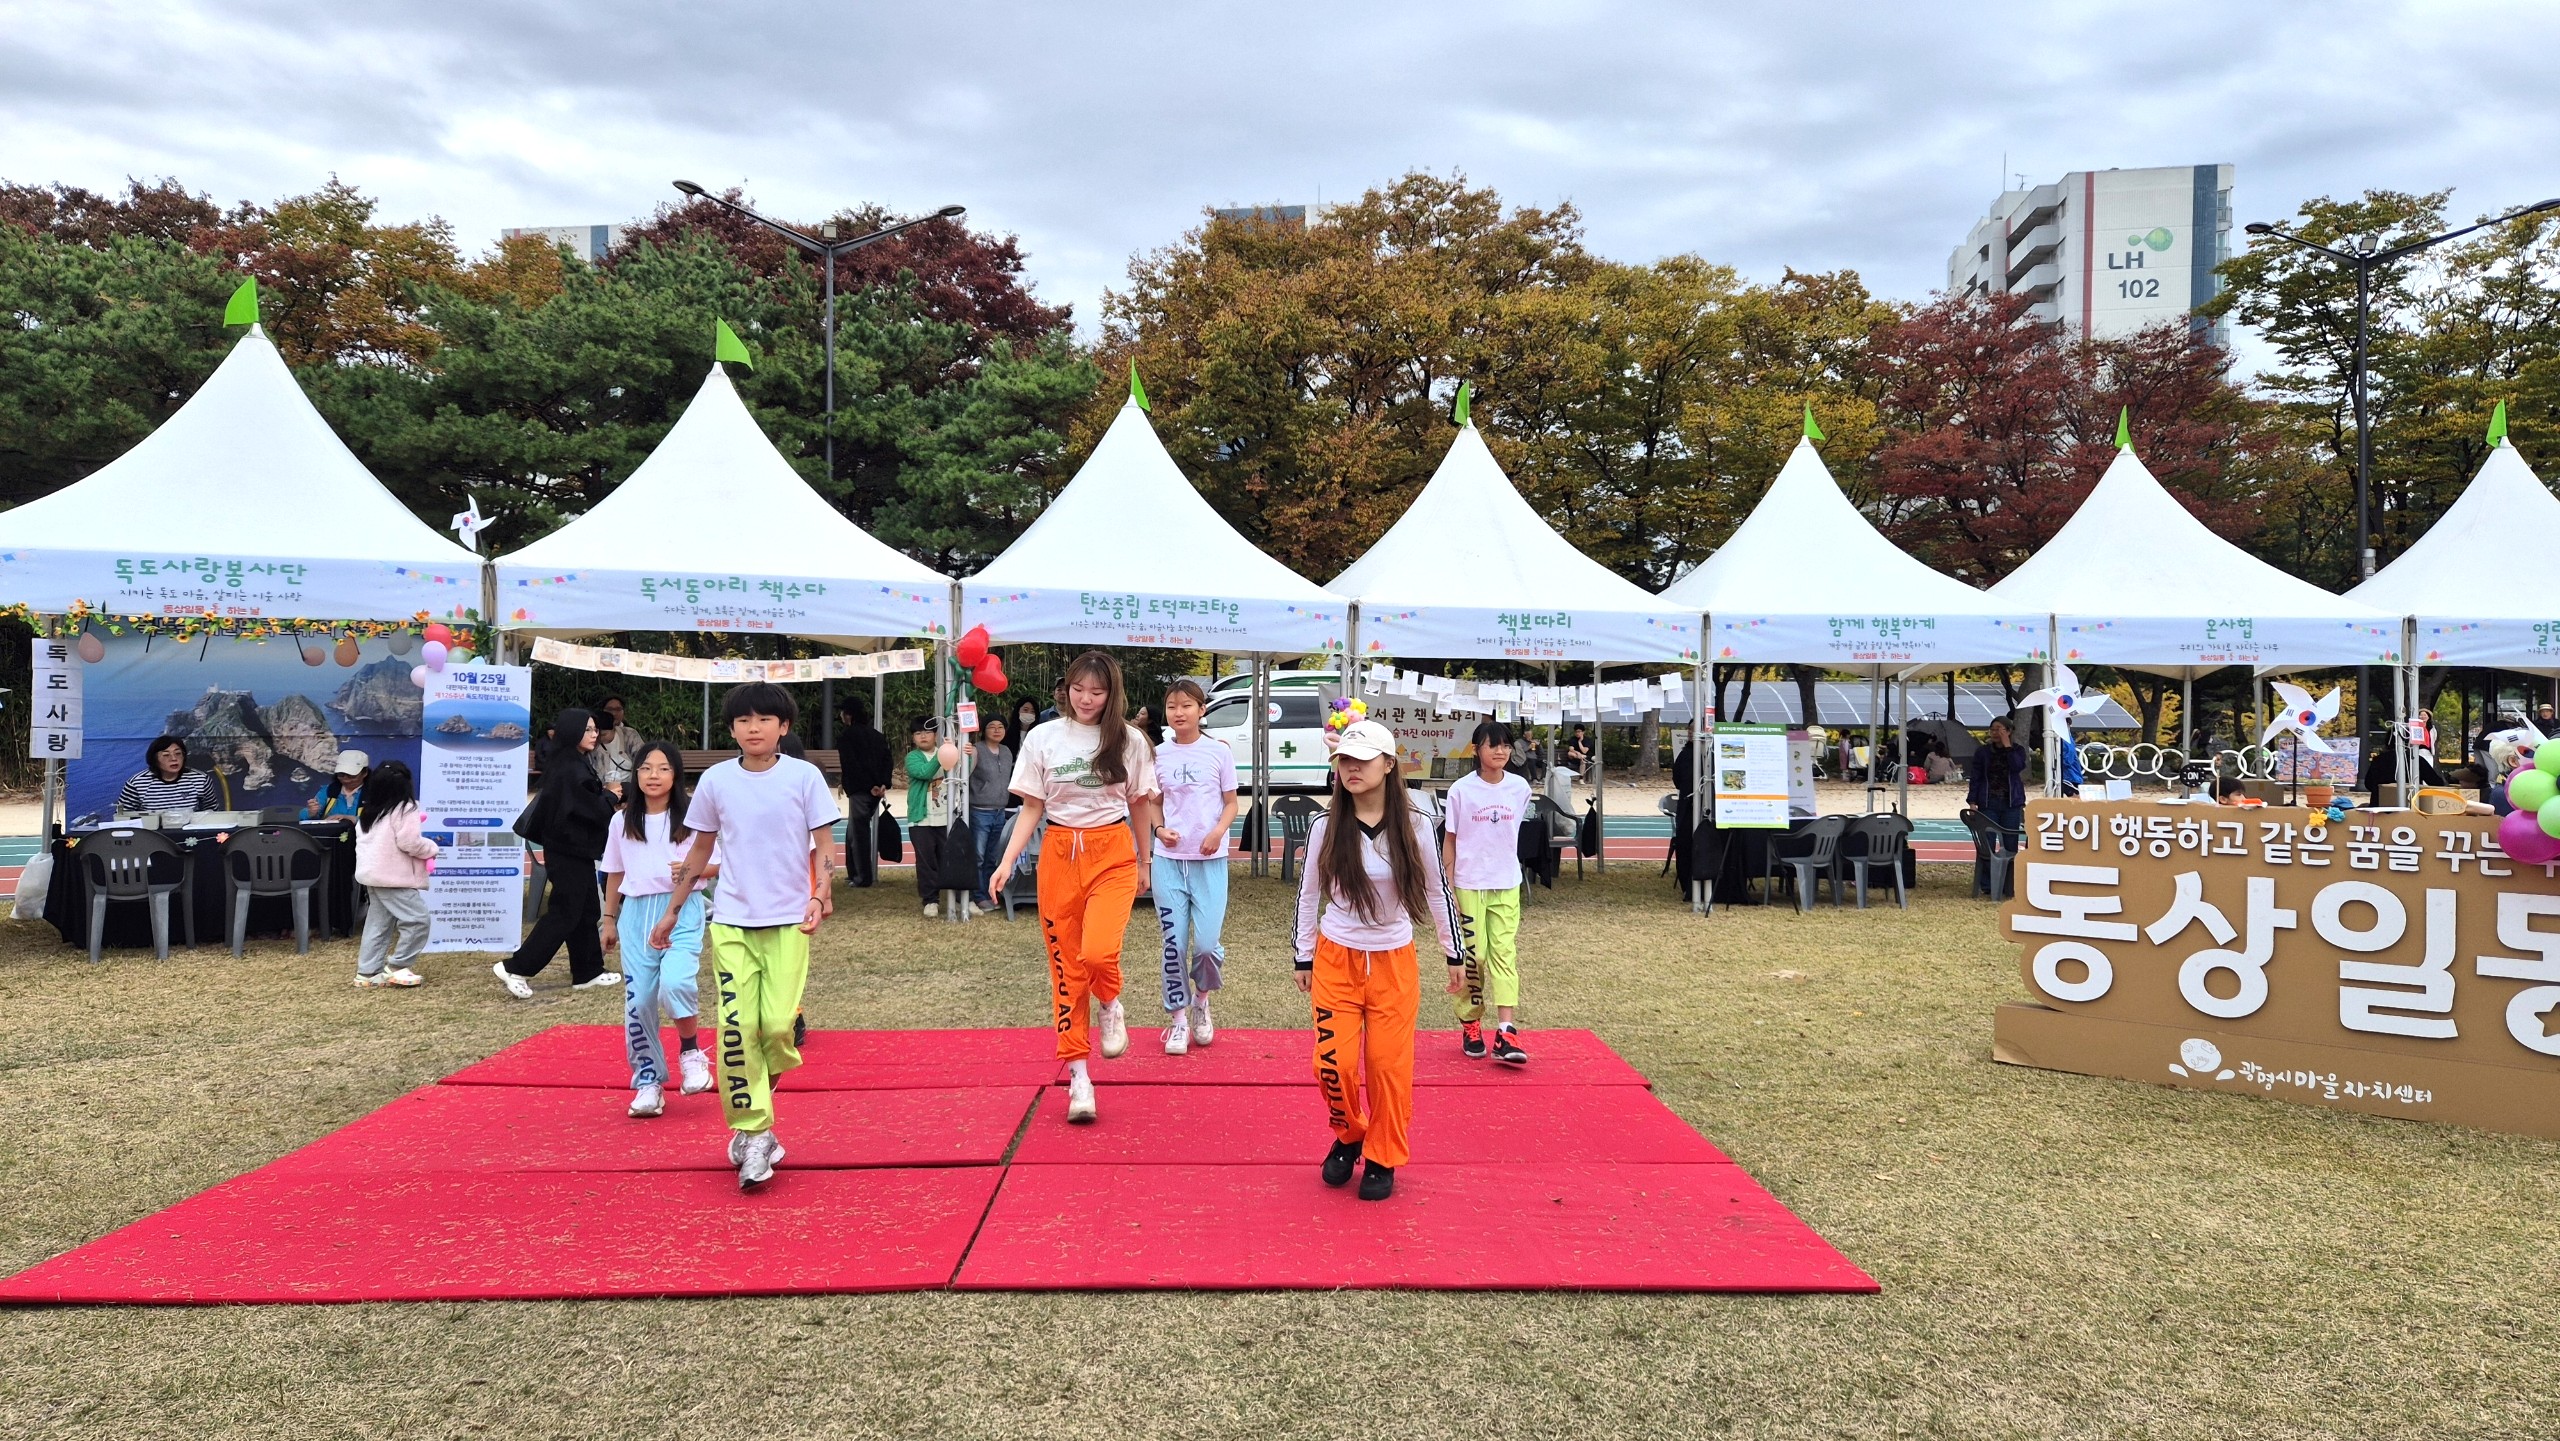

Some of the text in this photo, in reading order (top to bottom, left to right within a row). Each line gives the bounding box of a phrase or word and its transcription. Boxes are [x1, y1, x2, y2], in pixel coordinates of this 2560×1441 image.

[2108, 251, 2144, 270] LH
[2118, 278, 2160, 299] 102
[114, 557, 307, 588] 독도사랑봉사단
[120, 586, 154, 599] 지키는
[159, 587, 177, 599] 독도
[212, 589, 247, 602] 살피는
[252, 590, 273, 603] 이웃
[277, 592, 302, 603] 사랑
[640, 577, 826, 604] 독서동아리 책수다
[227, 606, 247, 615] 하는
[250, 607, 260, 616] 날
[664, 605, 686, 615] 수다는
[715, 605, 735, 616] 초록은
[762, 607, 784, 618] 마음은
[1080, 592, 1239, 624] 탄소중립 도덕파크타운
[747, 620, 763, 629] 하는
[765, 620, 774, 629] 날
[1497, 612, 1571, 636] 책보따리
[1828, 617, 1864, 637] 함께
[2206, 618, 2253, 640] 온사협
[1170, 636, 1184, 644] 하는
[452, 672, 506, 685] 10월 25일
[47, 645, 68, 752] 독도사랑
[1365, 707, 1405, 722] 서관
[1421, 729, 1455, 739] 이야기들
[2188, 772, 2198, 780] ON
[2038, 812, 2100, 851] 같이
[2109, 812, 2249, 858] 행동하고
[2260, 822, 2334, 866] 같은
[2346, 826, 2424, 872] 꿈을
[2436, 830, 2513, 876] 꾸는
[723, 1009, 746, 1068] YOU
[728, 1076, 752, 1109] AG
